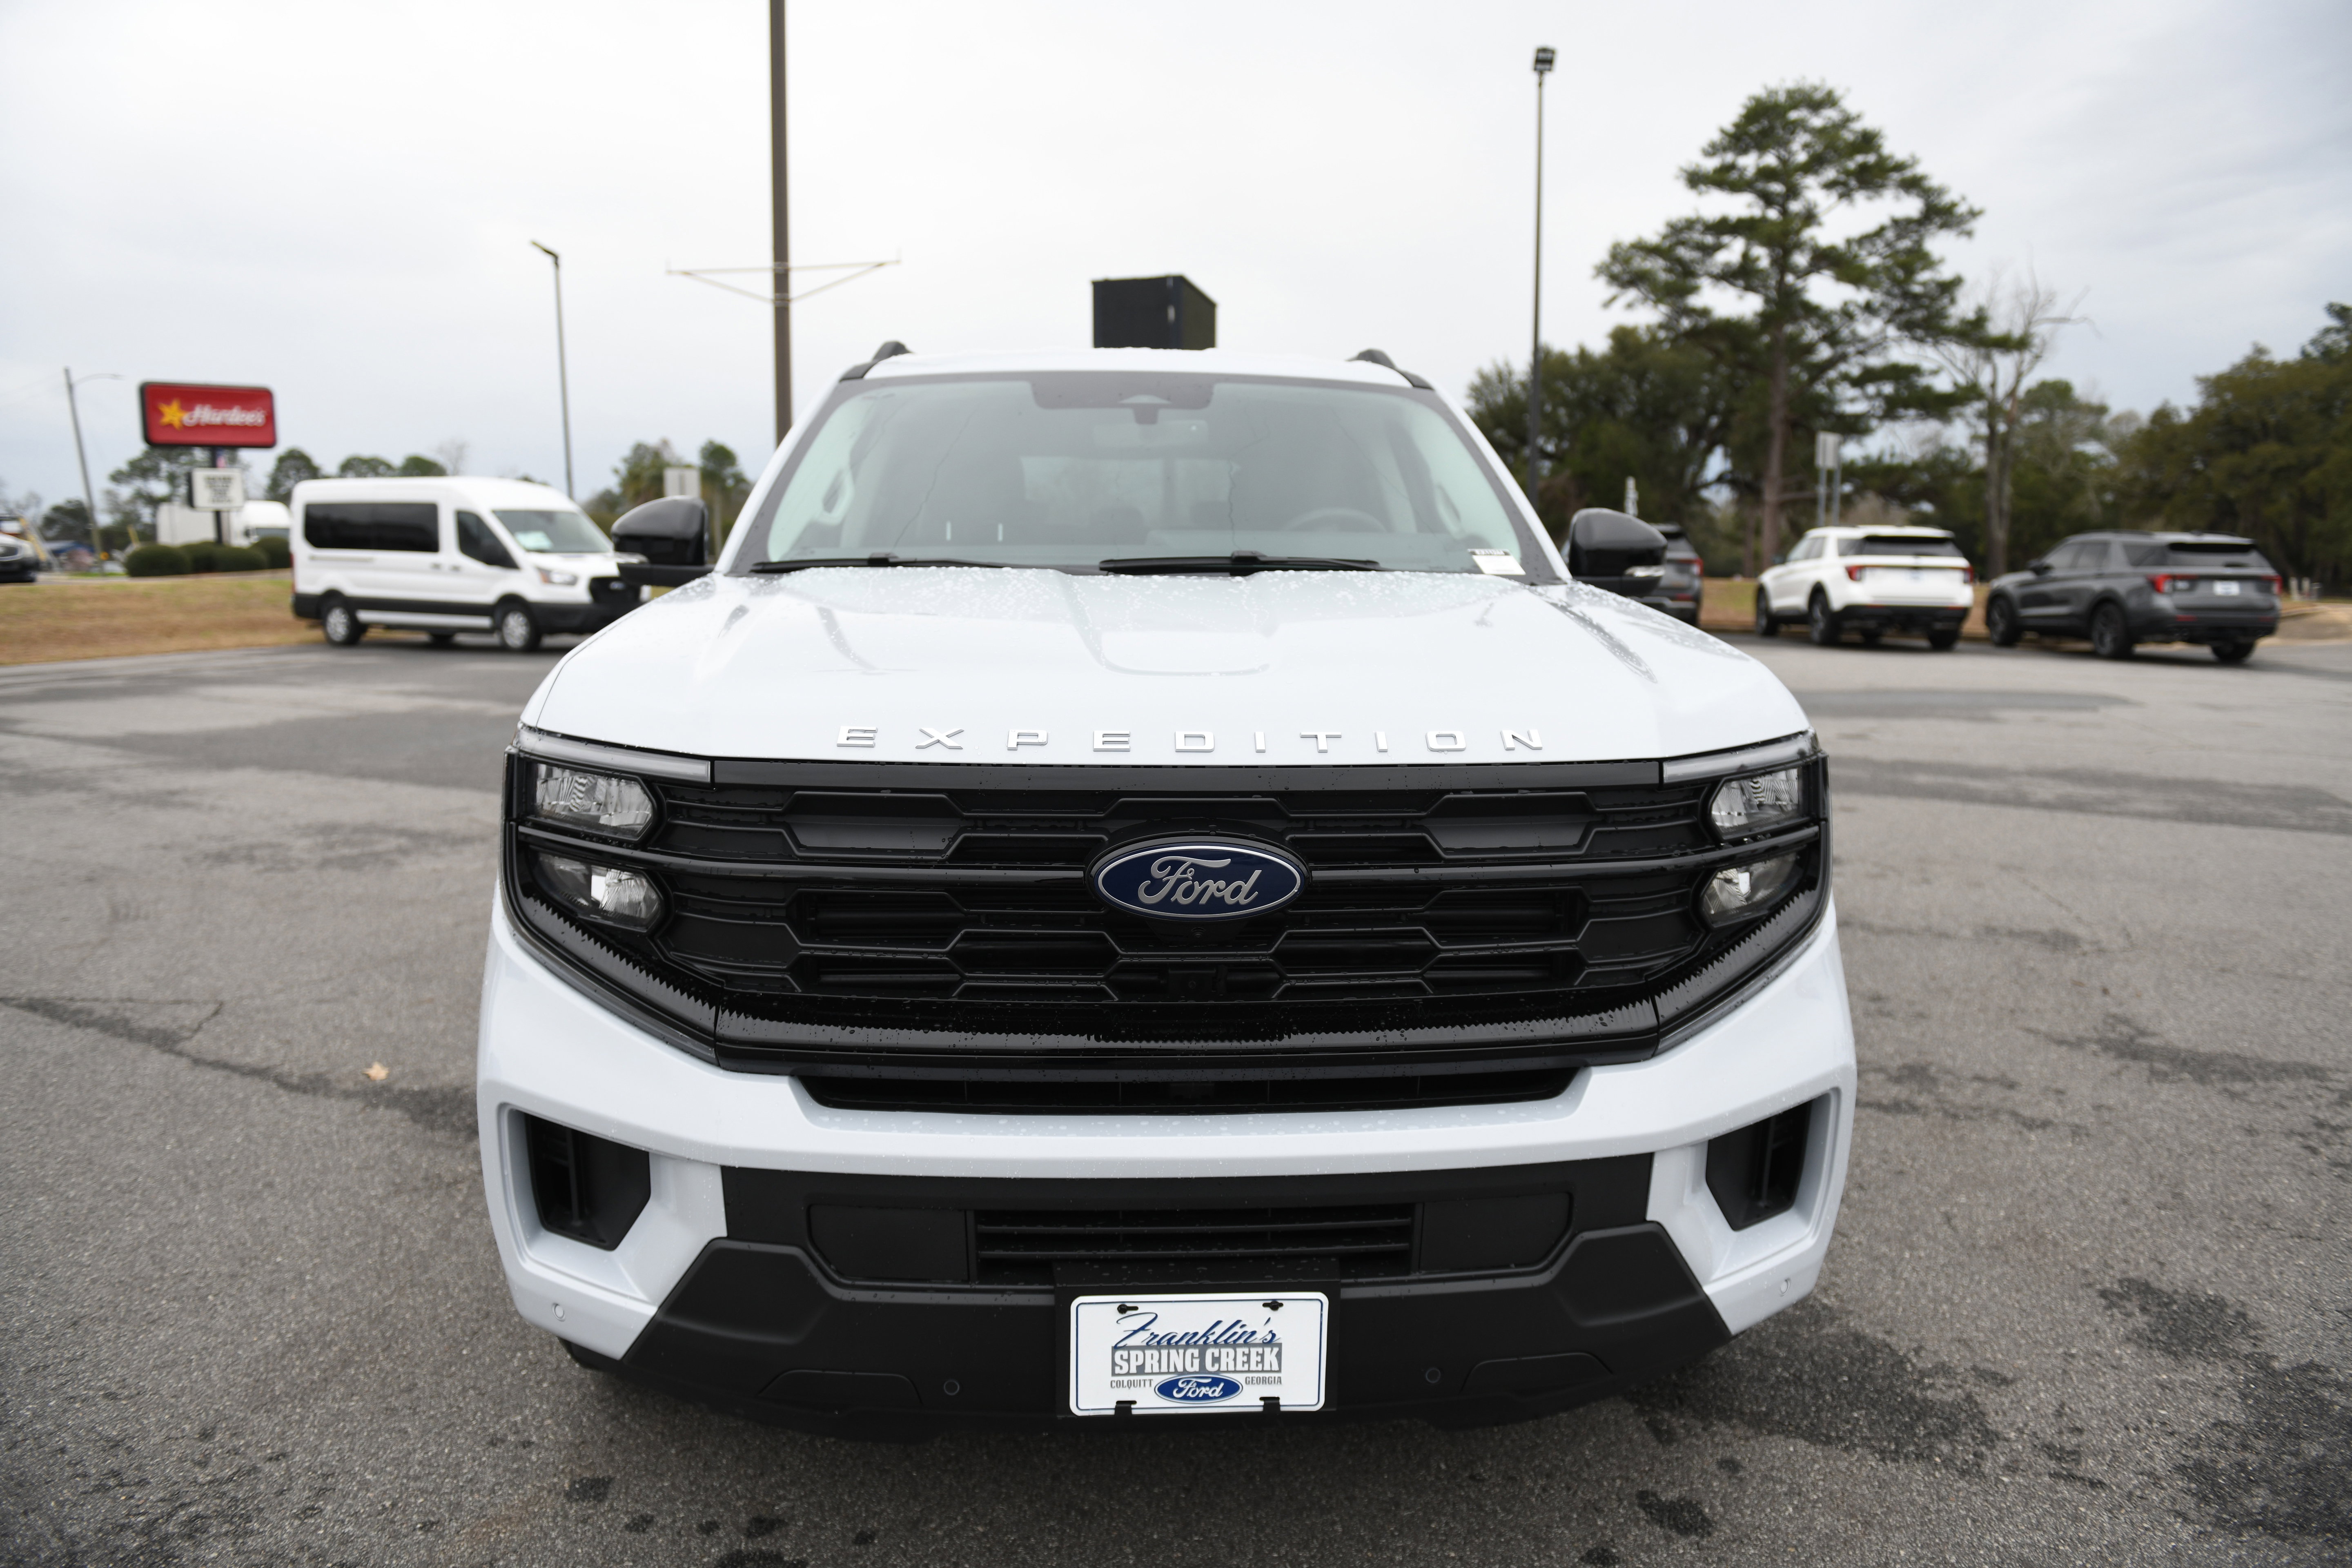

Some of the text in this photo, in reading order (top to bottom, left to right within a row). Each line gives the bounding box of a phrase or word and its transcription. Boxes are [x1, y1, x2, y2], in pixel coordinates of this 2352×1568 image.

[183, 404, 267, 427] Hardee's
[836, 726, 1543, 754] EXPEDITION
[1138, 855, 1262, 905] Ford
[1114, 1312, 1282, 1350] Franklin's
[1114, 1347, 1280, 1374] SPRING CREEK
[1110, 1379, 1154, 1389] COLQUITT
[1172, 1377, 1224, 1398] Ford
[1245, 1376, 1283, 1385] GEORGIA
